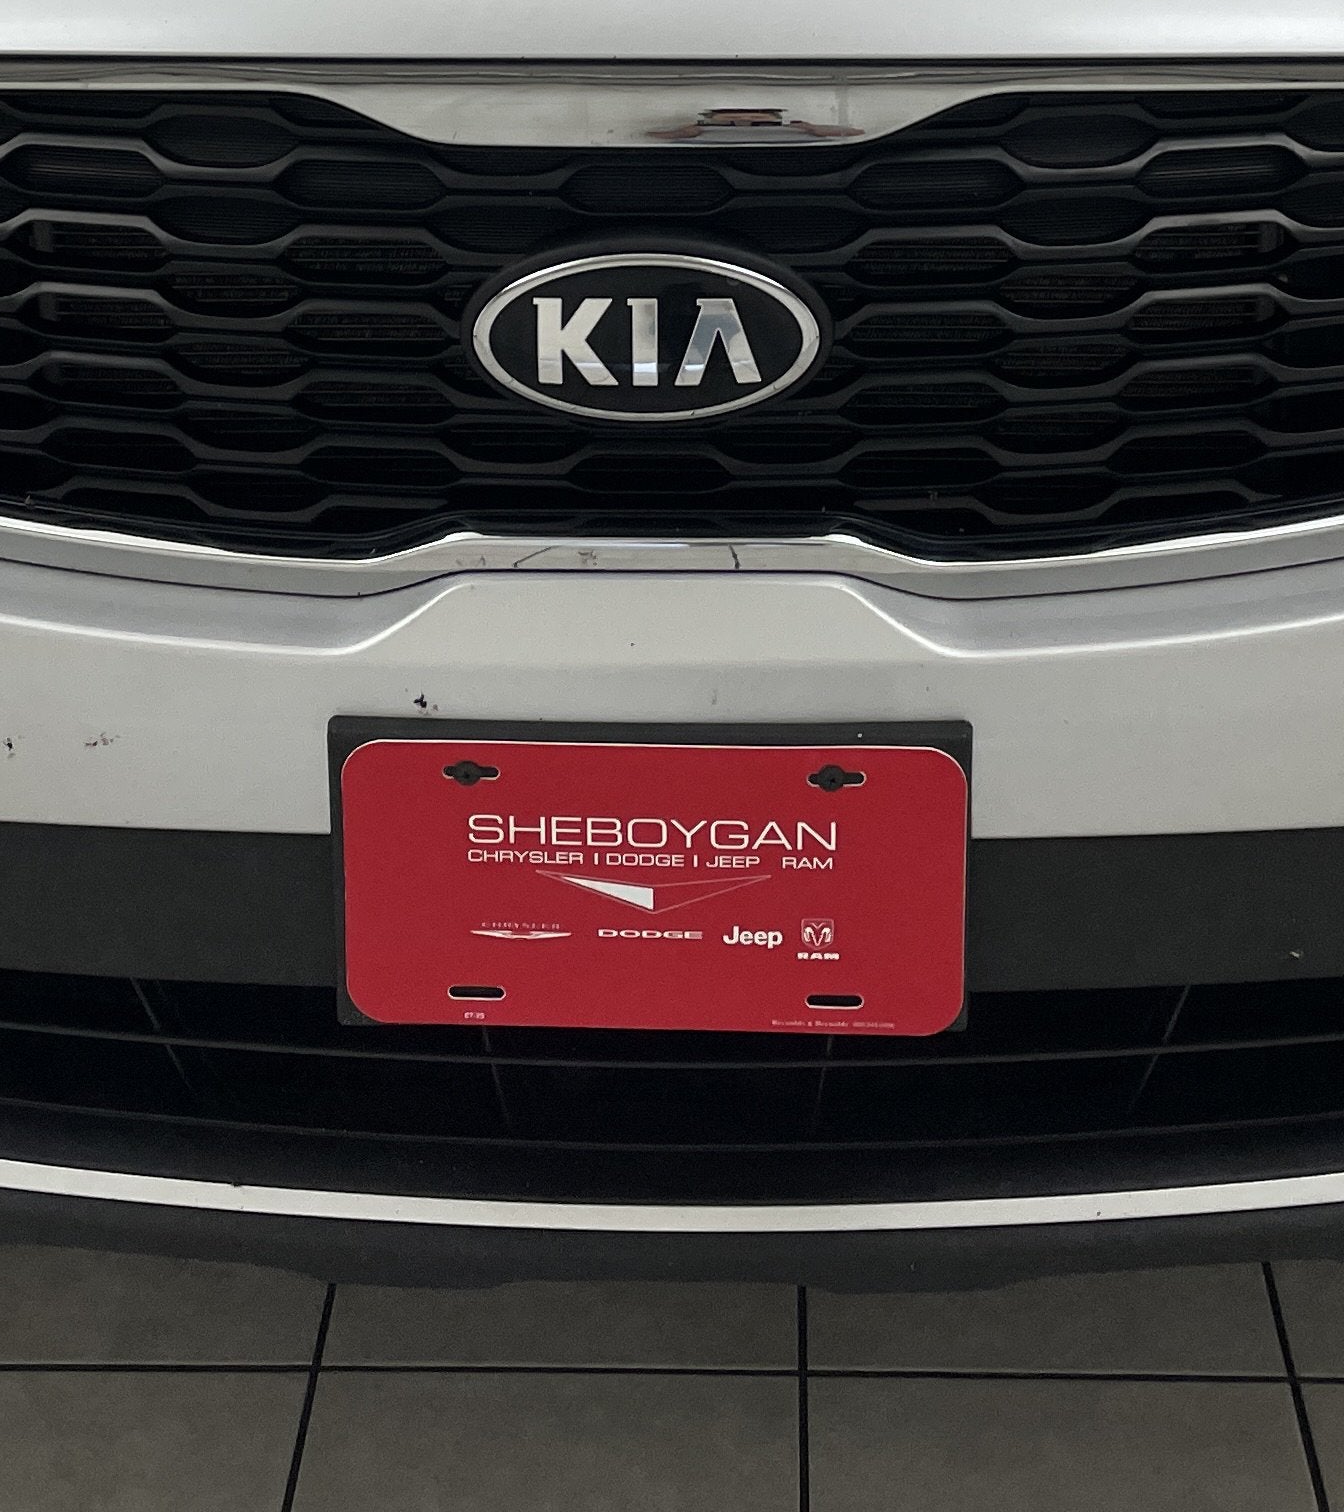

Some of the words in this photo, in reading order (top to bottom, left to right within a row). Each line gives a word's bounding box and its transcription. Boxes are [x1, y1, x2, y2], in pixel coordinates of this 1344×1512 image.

[532, 297, 762, 386] KIA
[468, 814, 837, 851] SHEBOYGAN
[467, 849, 584, 865] CHRYSLER
[606, 852, 685, 867] DODGE
[706, 855, 760, 869] JEEP
[782, 856, 834, 869] RAM
[598, 928, 703, 939] DODGE
[723, 925, 784, 949] Jeep
[797, 952, 840, 960] RAM
